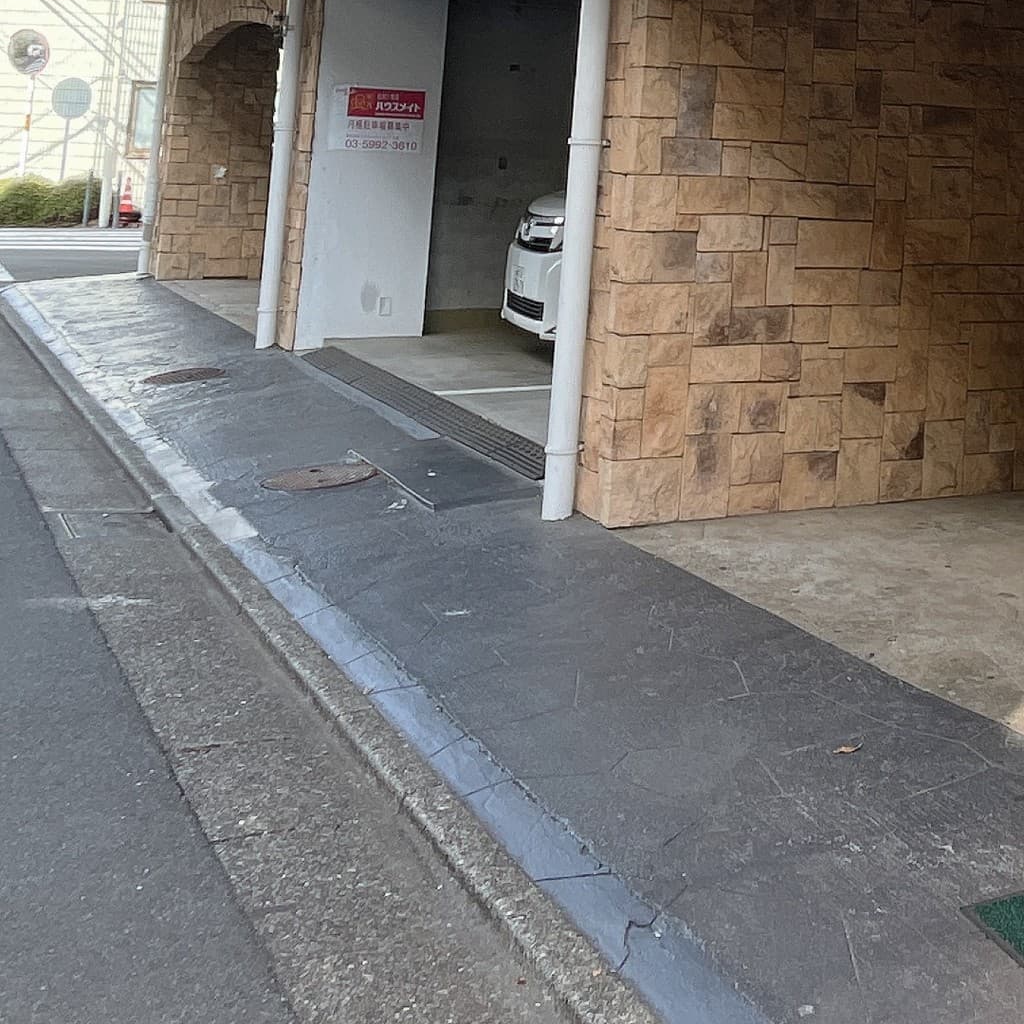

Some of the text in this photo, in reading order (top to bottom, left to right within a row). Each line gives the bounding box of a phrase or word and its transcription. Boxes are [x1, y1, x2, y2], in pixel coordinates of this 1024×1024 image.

[375, 102, 420, 113] ハウスメイト
